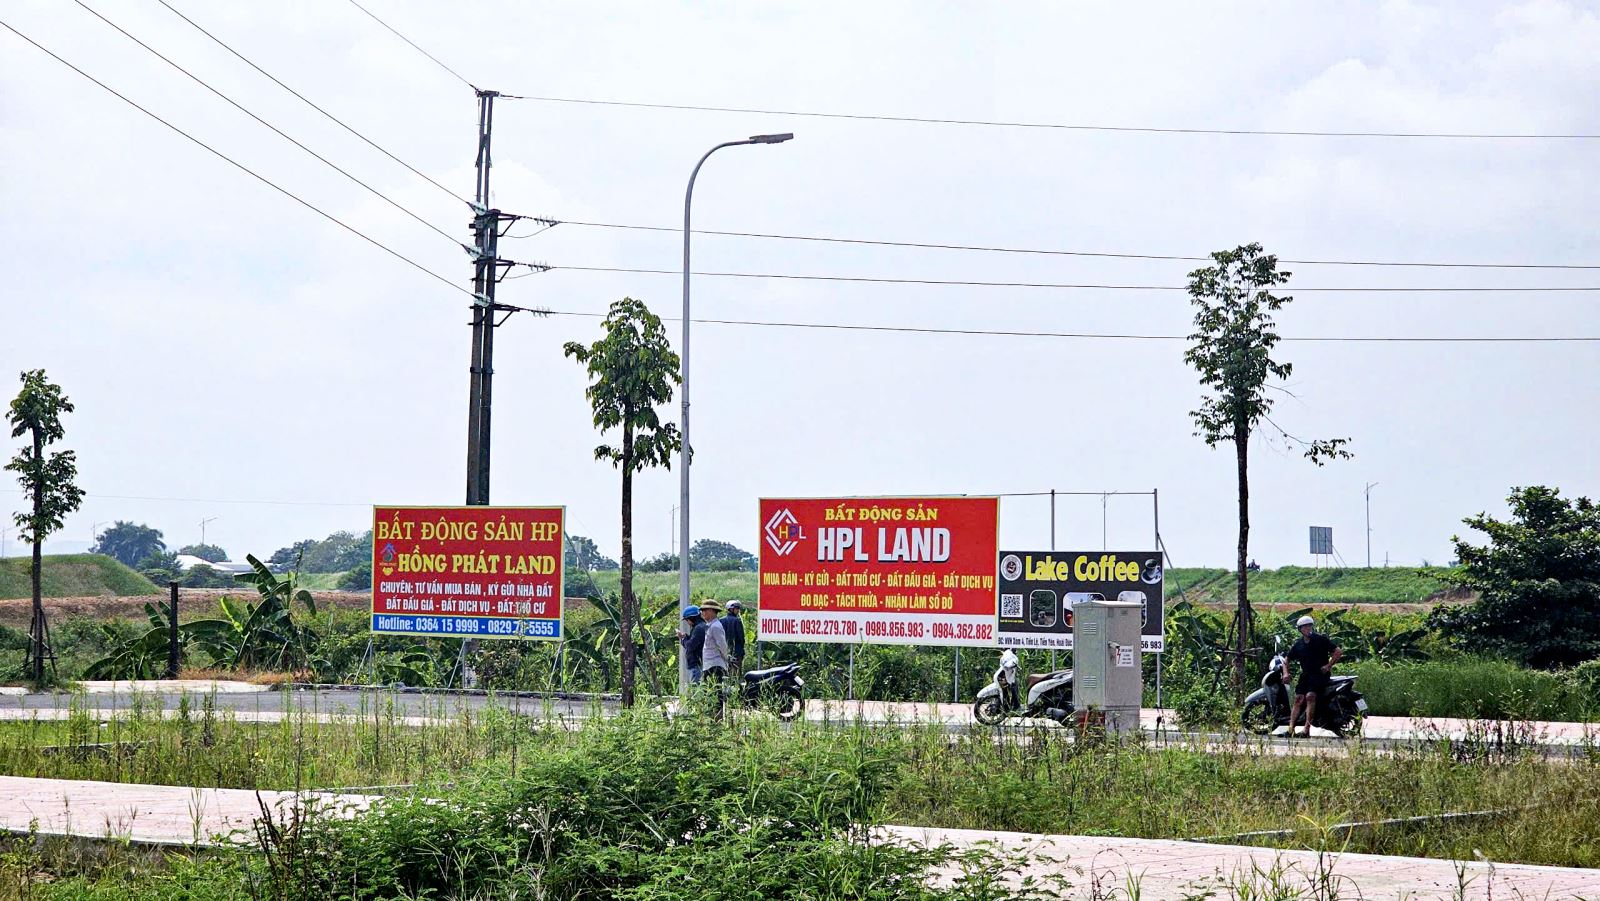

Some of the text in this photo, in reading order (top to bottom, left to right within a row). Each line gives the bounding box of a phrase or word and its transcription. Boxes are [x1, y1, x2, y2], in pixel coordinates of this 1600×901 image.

[825, 504, 938, 523] BẤT ĐỘNG SẢN
[378, 511, 558, 545] BẤT ĐỘNG SẢN HP
[817, 527, 950, 563] HPL LAND
[398, 545, 556, 574] HỒNG PHÁT LAND
[1025, 555, 1139, 582] Lake Coffee
[380, 580, 413, 593] CHUYÊN:
[415, 582, 425, 594] TƯ
[427, 578, 442, 595] VẤN
[444, 584, 462, 595] MUA
[464, 582, 481, 595] BÁN
[488, 584, 500, 596] KÝ
[501, 582, 515, 596] GỬI
[517, 585, 535, 597] NHÀ
[536, 583, 552, 597] ĐẤT
[764, 573, 780, 585] MUA
[782, 572, 798, 586] BÁN
[804, 572, 815, 586] KÝ
[816, 569, 830, 586] GỬI
[836, 572, 853, 587] ĐẤT
[854, 569, 869, 587] THỔ
[870, 574, 881, 587] CƯ
[888, 572, 903, 588] ĐẤT
[905, 573, 922, 588] ĐẤU
[923, 575, 936, 588] GIÁ
[944, 573, 960, 588] ĐẤT
[961, 576, 982, 591] DỊCH
[983, 576, 993, 592] VỤ
[386, 597, 401, 610] ĐẤT
[403, 598, 419, 611] ĐẤU
[421, 599, 434, 611] GIÁ
[441, 599, 456, 612] ĐẤT
[458, 602, 478, 613] DỊCH
[480, 602, 490, 614] VỤ
[497, 600, 513, 613] ĐẤT
[533, 603, 546, 614] CƯ
[801, 595, 812, 607] ĐO
[813, 595, 829, 610] ĐẠC
[836, 592, 858, 607] TÁCH
[860, 591, 878, 607] THỬA
[886, 594, 909, 611] NHẬN
[910, 594, 927, 609] LÀM
[928, 592, 940, 609] SỔ
[941, 593, 952, 610] ĐỎ
[378, 618, 413, 630] Hotline:
[416, 618, 438, 631] 0364
[442, 620, 453, 632] 15
[456, 620, 478, 632] 9999
[488, 621, 511, 634] 0829
[529, 623, 553, 635] 5555
[762, 618, 798, 634] HOTLINE:
[801, 620, 857, 636] 0932.279.780
[866, 622, 923, 637] 0989.856.983
[932, 623, 992, 639] 0984.362.882
[1150, 641, 1162, 649] 983
